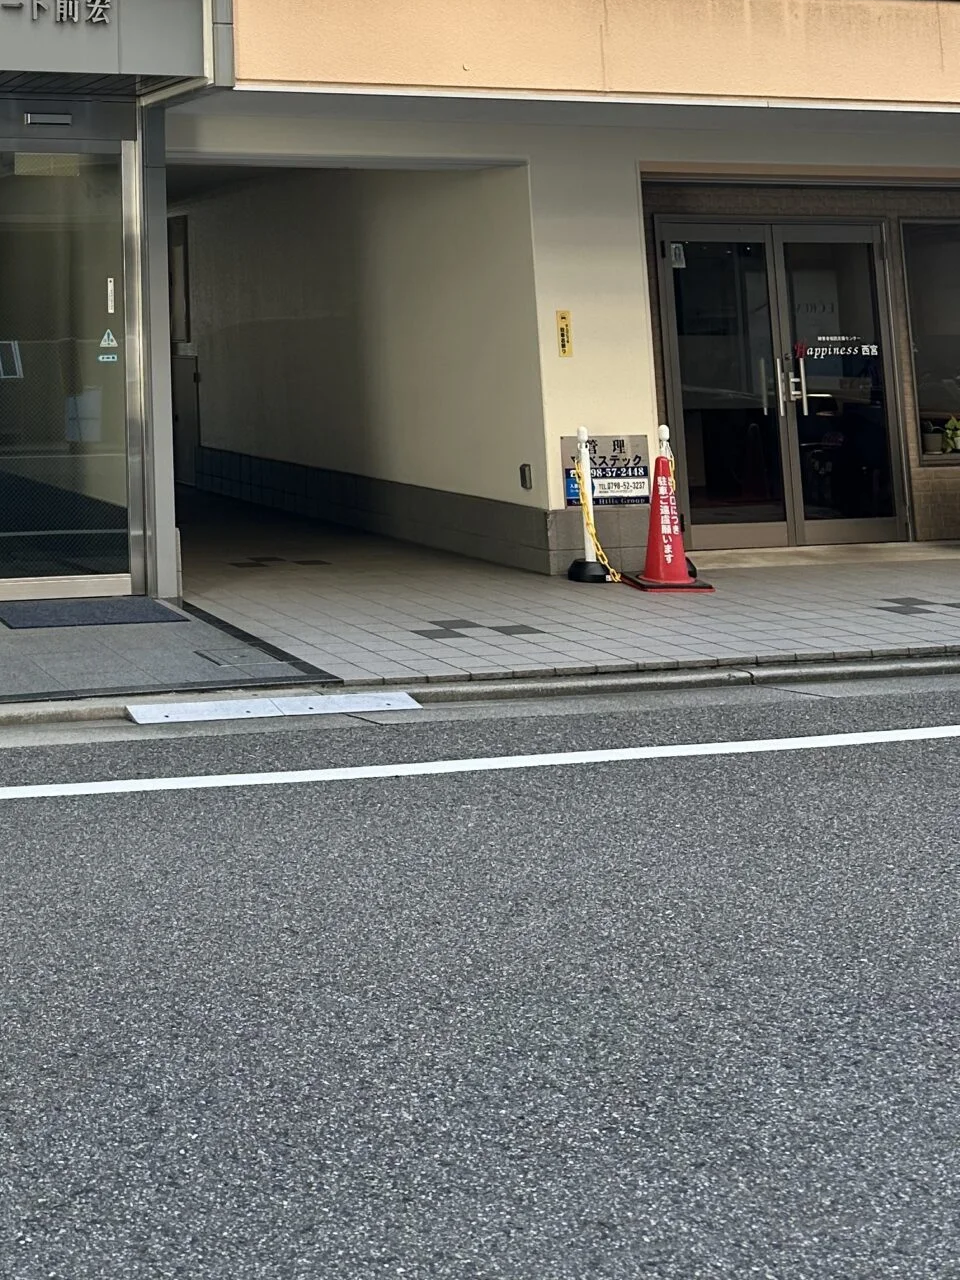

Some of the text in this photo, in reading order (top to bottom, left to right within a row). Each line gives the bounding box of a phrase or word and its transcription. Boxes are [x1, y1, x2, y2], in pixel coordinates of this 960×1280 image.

[795, 340, 879, 359] Happiness 西宮
[591, 467, 645, 478] 98-57-2448
